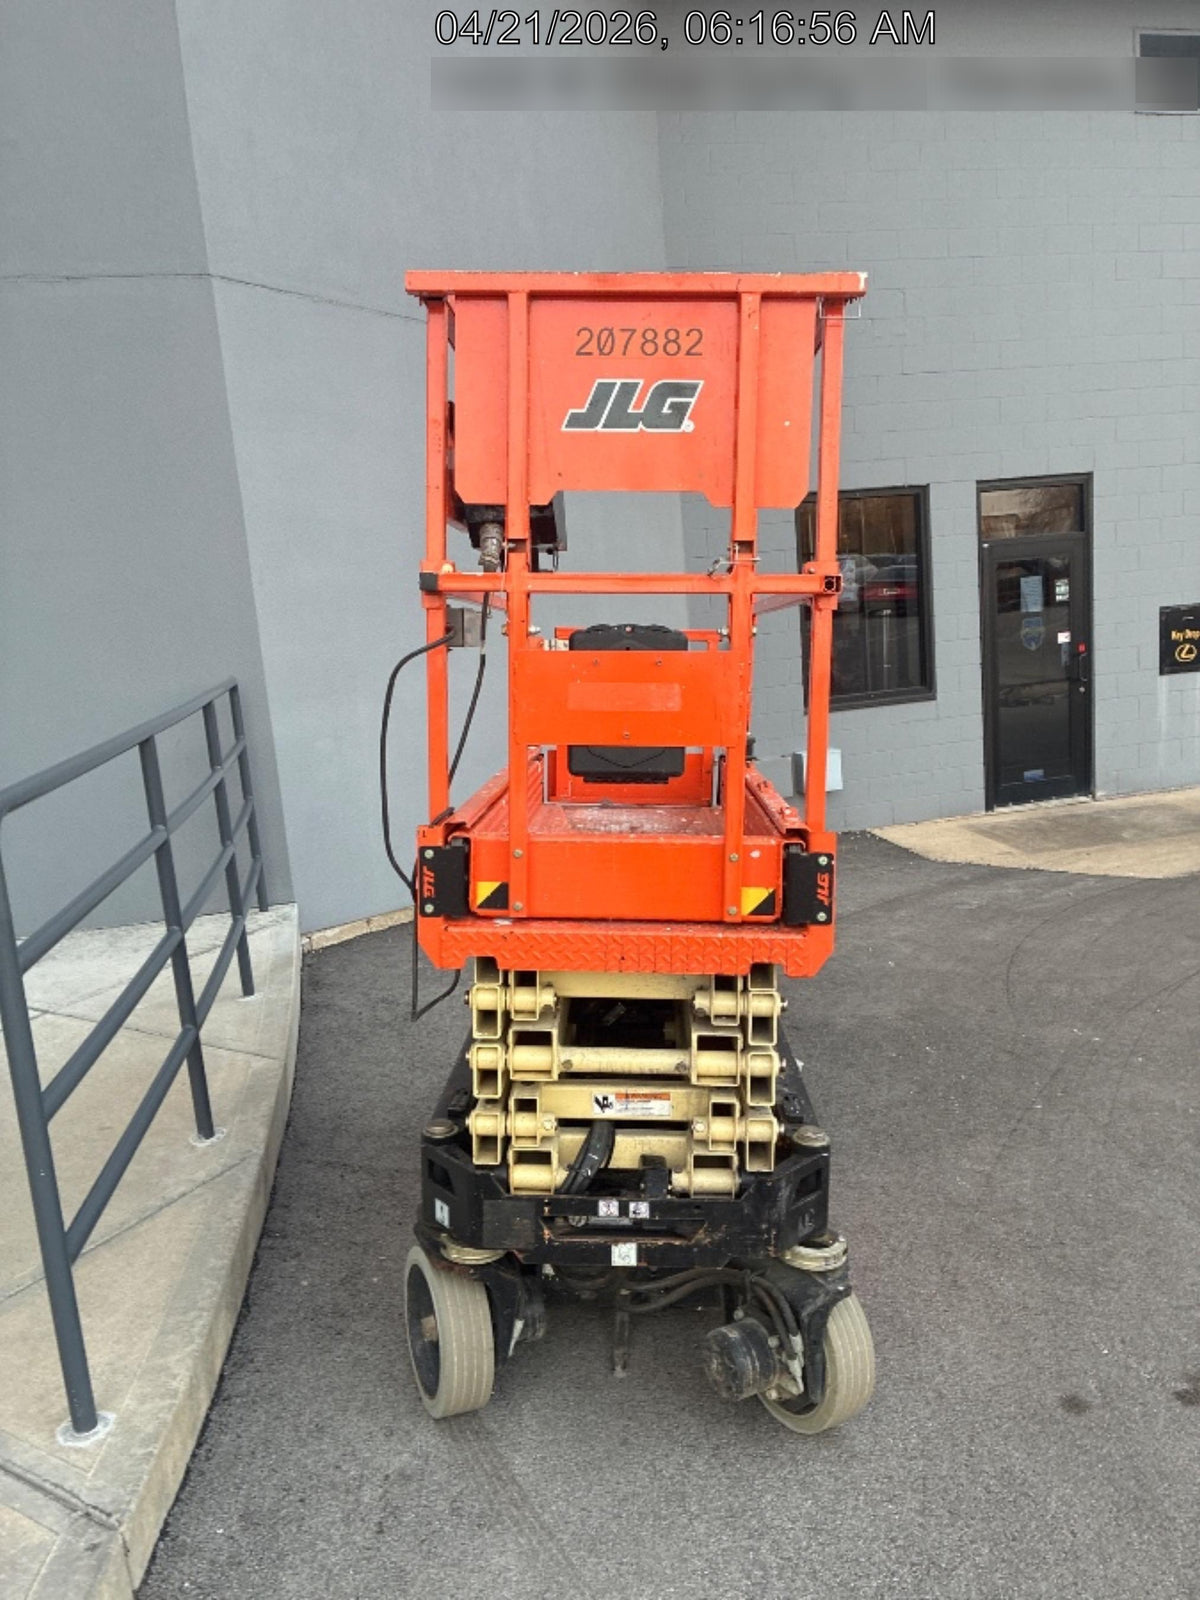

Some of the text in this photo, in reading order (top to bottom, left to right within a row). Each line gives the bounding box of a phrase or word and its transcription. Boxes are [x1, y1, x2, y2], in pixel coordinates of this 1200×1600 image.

[575, 327, 704, 356] 207882
[561, 379, 704, 432] JLG
[423, 866, 435, 898] JLG
[817, 872, 829, 906] JLG
